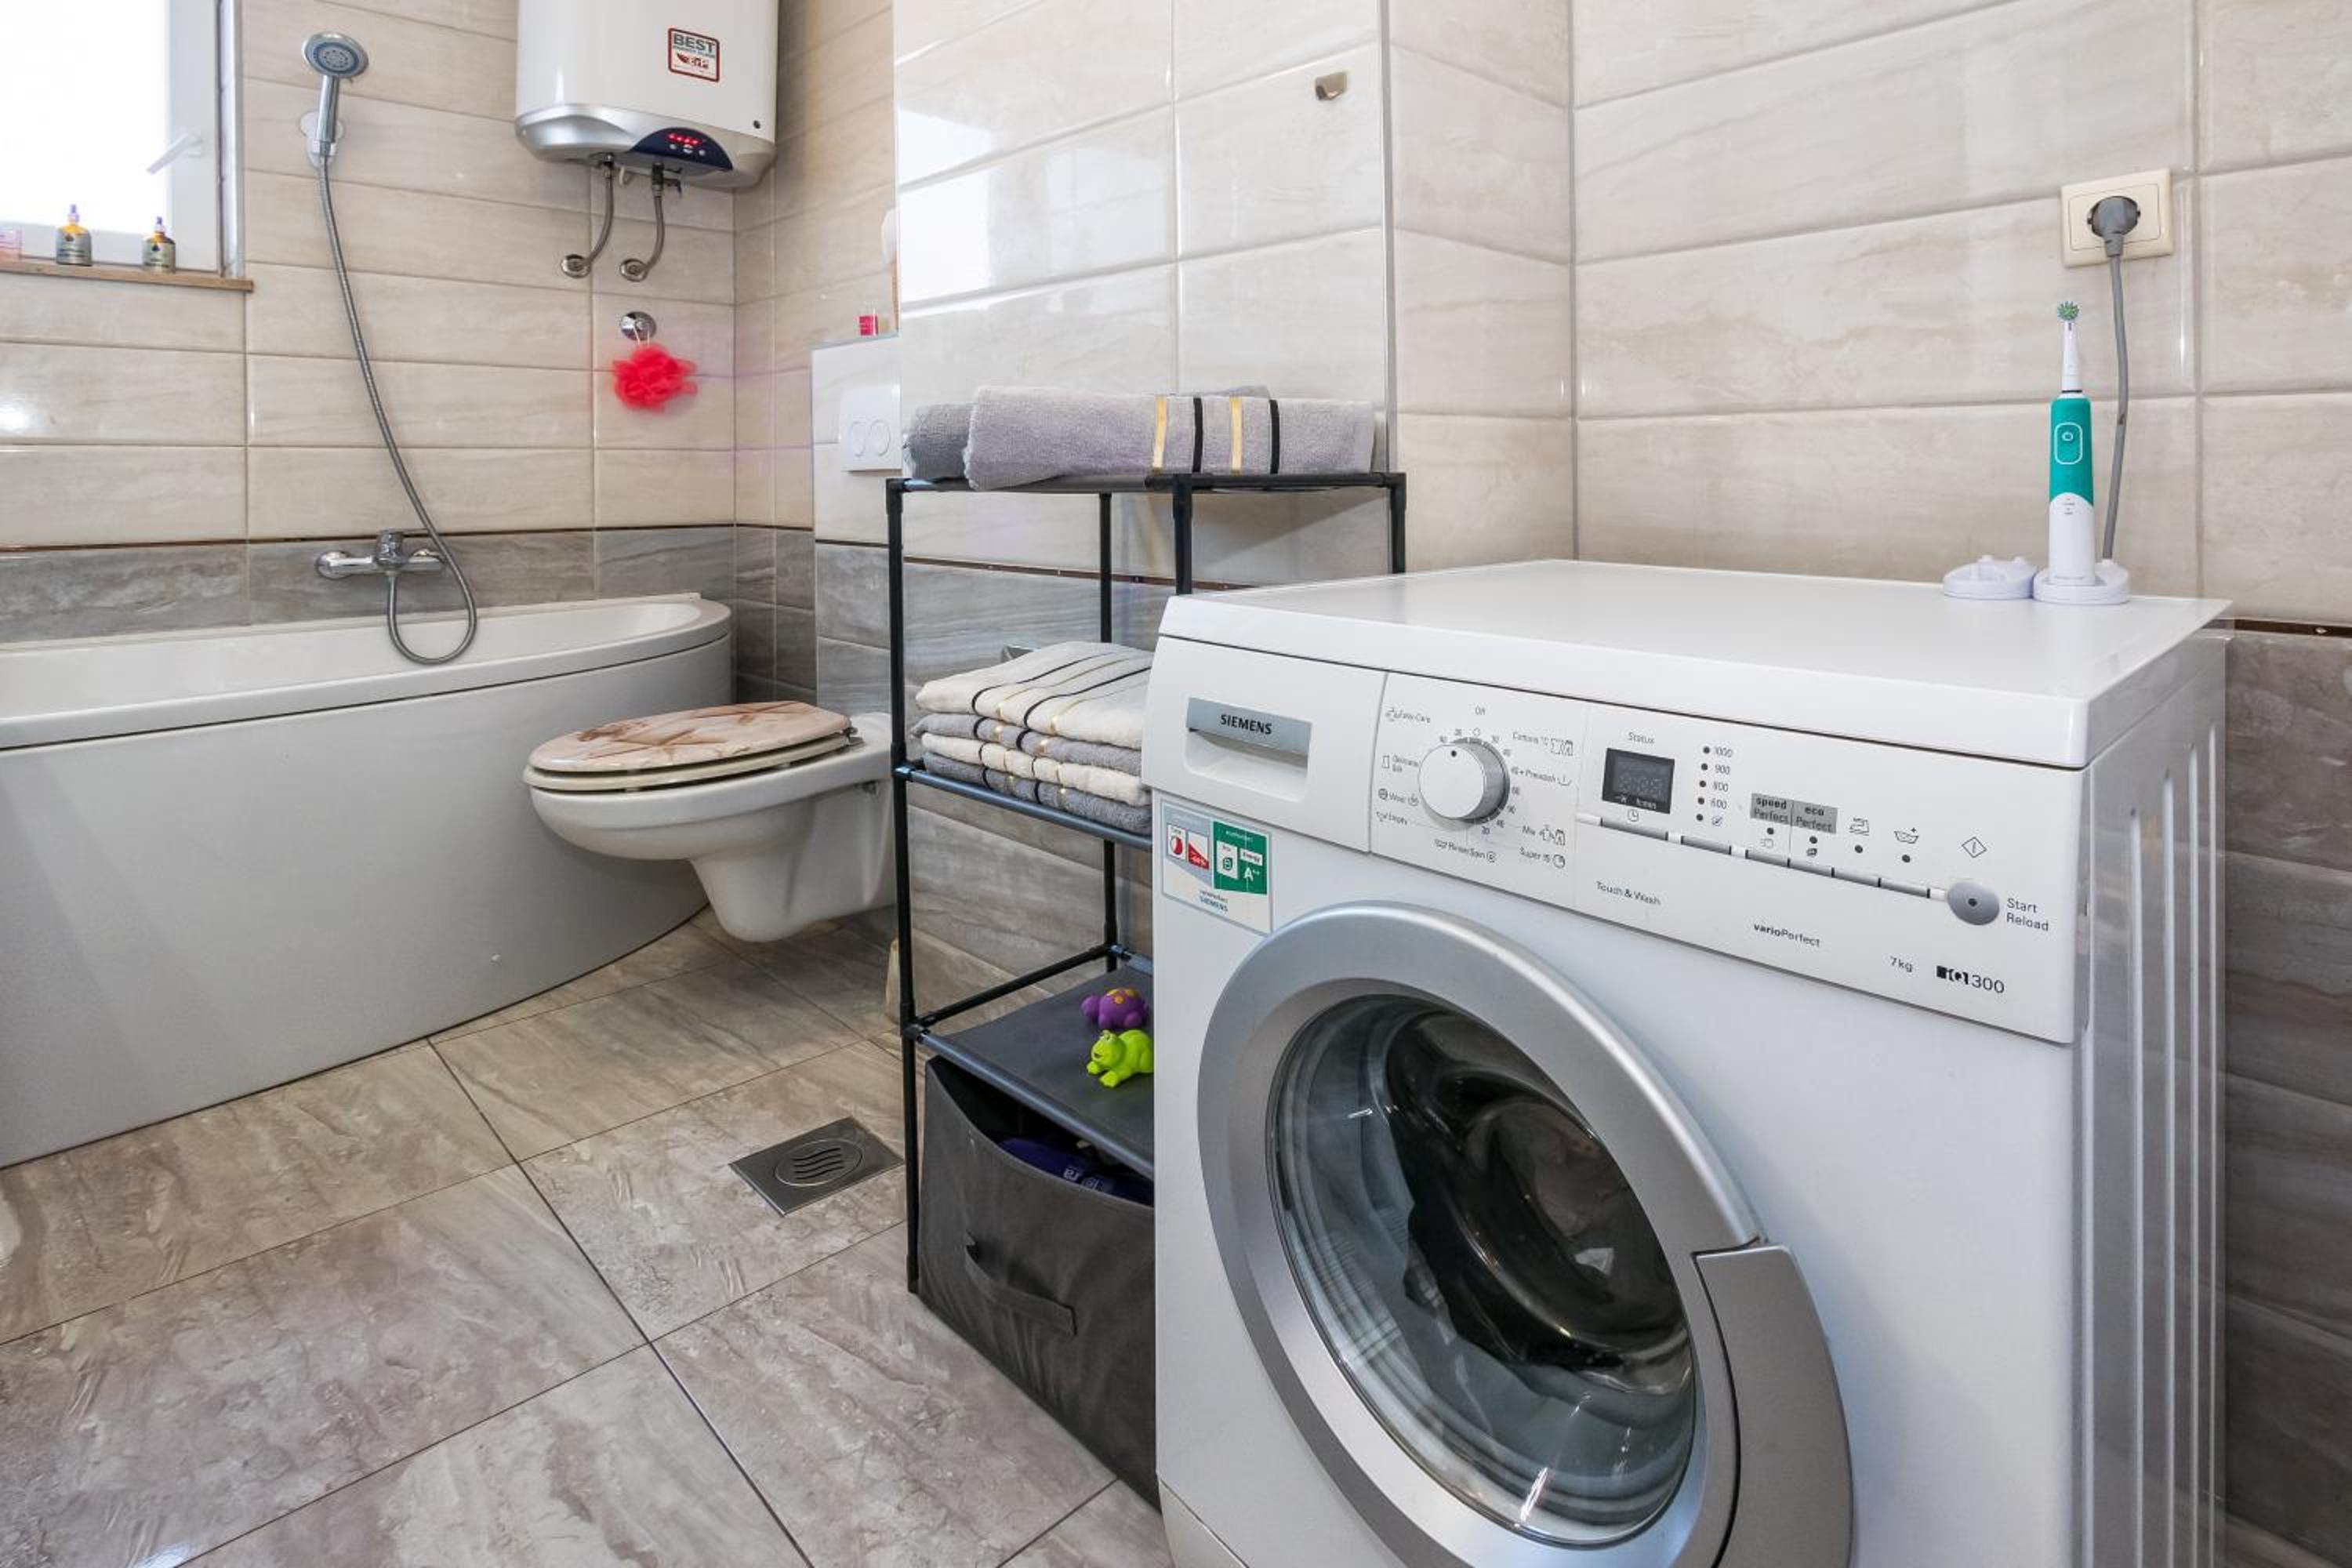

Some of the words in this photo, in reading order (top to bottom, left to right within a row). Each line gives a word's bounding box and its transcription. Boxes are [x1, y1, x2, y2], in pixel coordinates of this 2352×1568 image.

[673, 33, 715, 53] BEST
[1220, 714, 1272, 735] SIEMENS
[1628, 731, 1655, 744] Status
[1755, 797, 1788, 811] speed
[1804, 807, 1825, 817] eco
[1754, 808, 1789, 824] Perfect
[1796, 816, 1833, 833] Perfect
[2007, 898, 2038, 914] Start
[2006, 912, 2049, 932] Reload
[1754, 924, 1820, 948] varioPerfect
